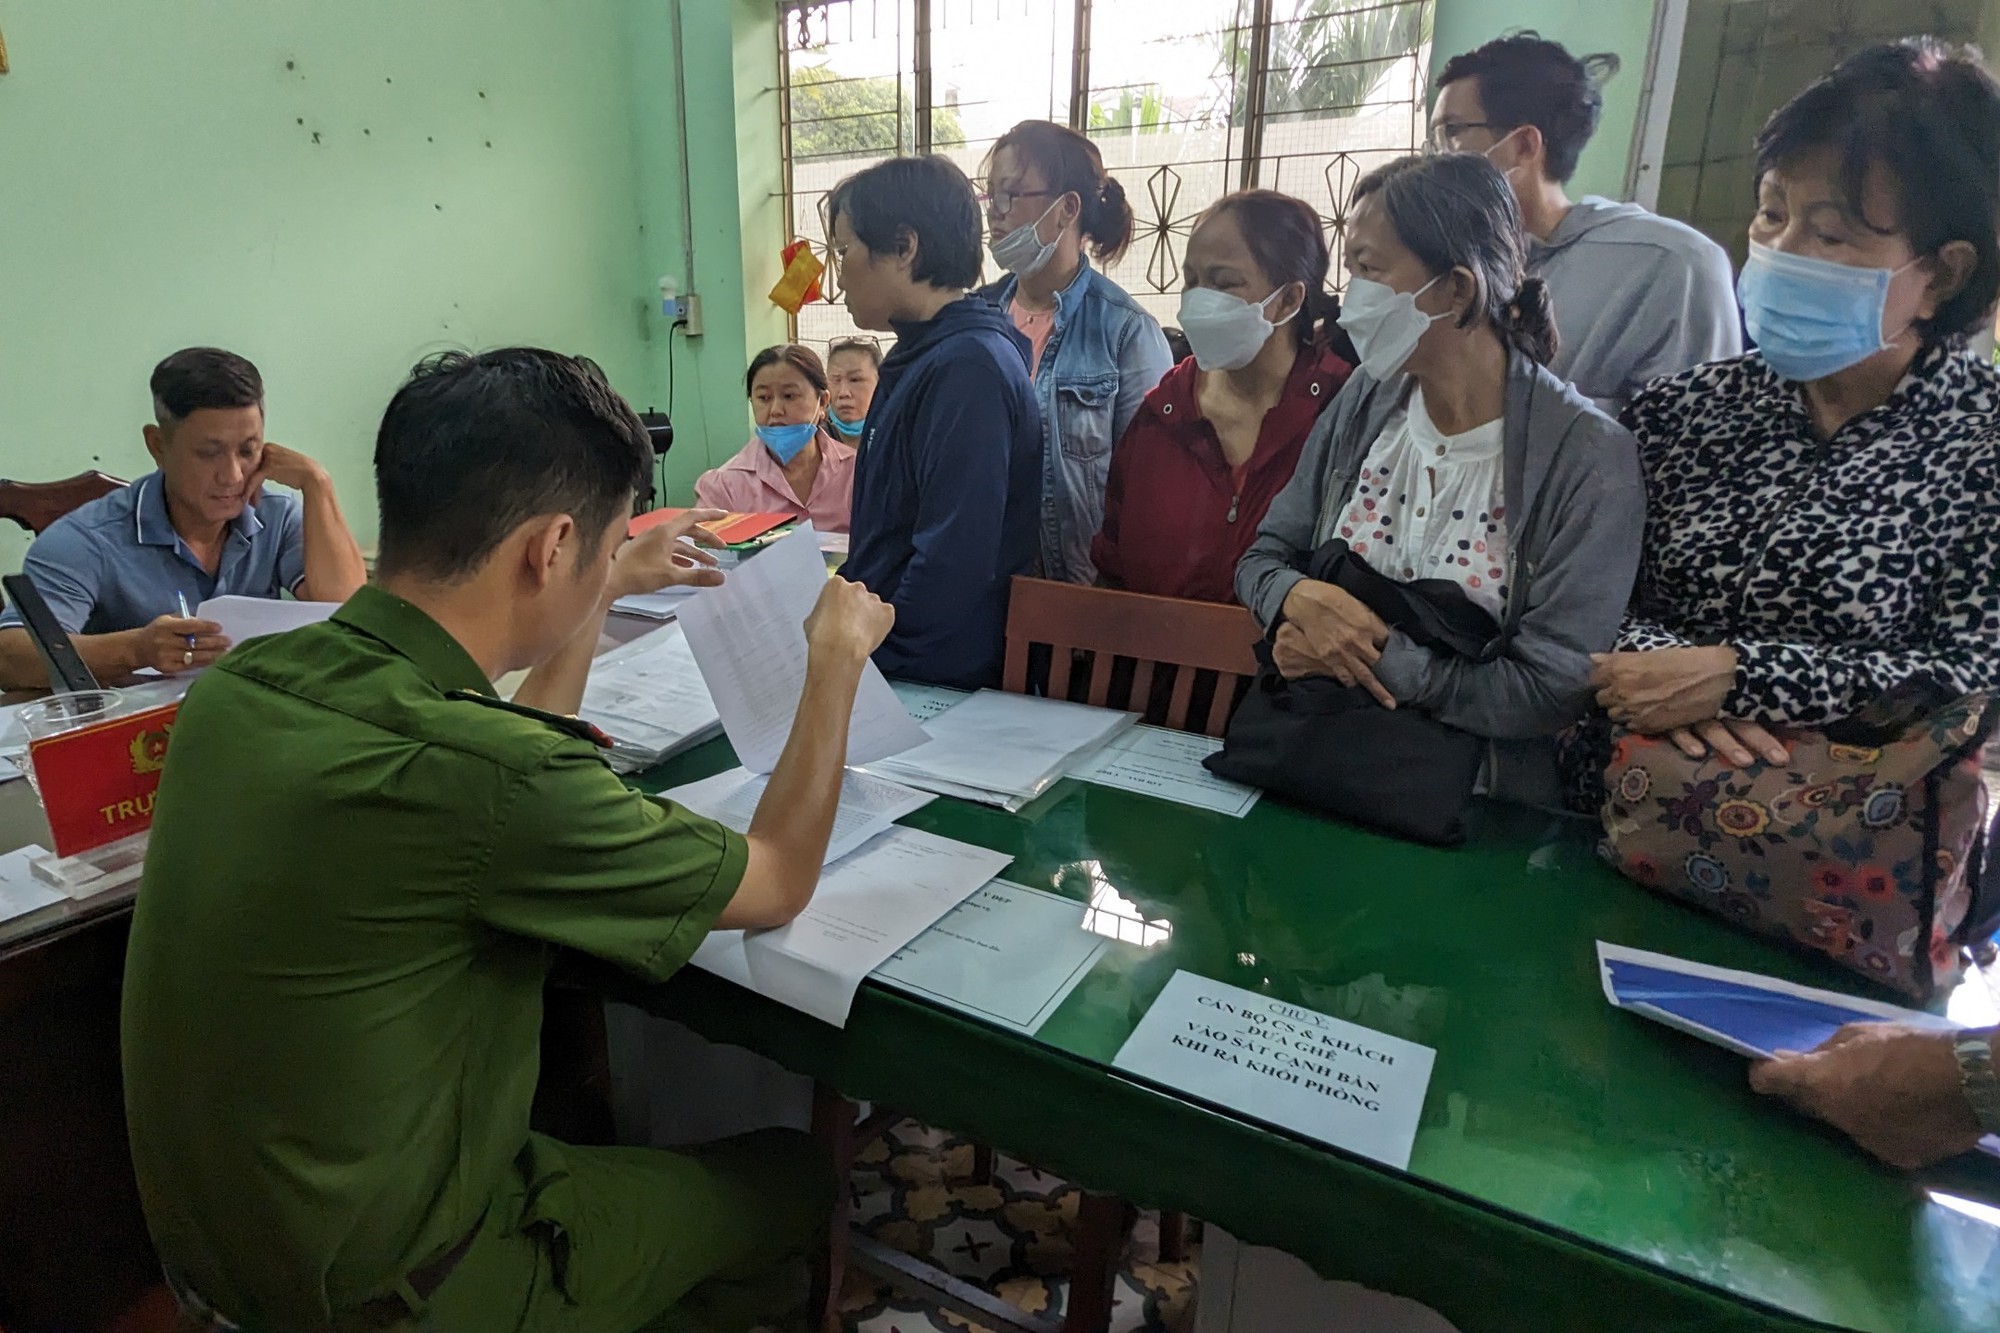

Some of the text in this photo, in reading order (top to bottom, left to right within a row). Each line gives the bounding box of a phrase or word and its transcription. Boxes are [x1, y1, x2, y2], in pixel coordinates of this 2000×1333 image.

[99, 790, 156, 824] TRỰ
[1188, 1021, 1380, 1093] VÀO SÁT CẠNH BÀN
[1197, 996, 1237, 1014] CÁN
[1272, 1020, 1296, 1033] CS
[1300, 1029, 1313, 1040] &
[1321, 1035, 1394, 1066] KHÁCH
[1171, 1034, 1209, 1053] KHI
[1213, 1047, 1239, 1065] RA
[1304, 1078, 1380, 1112] PHÒNG
